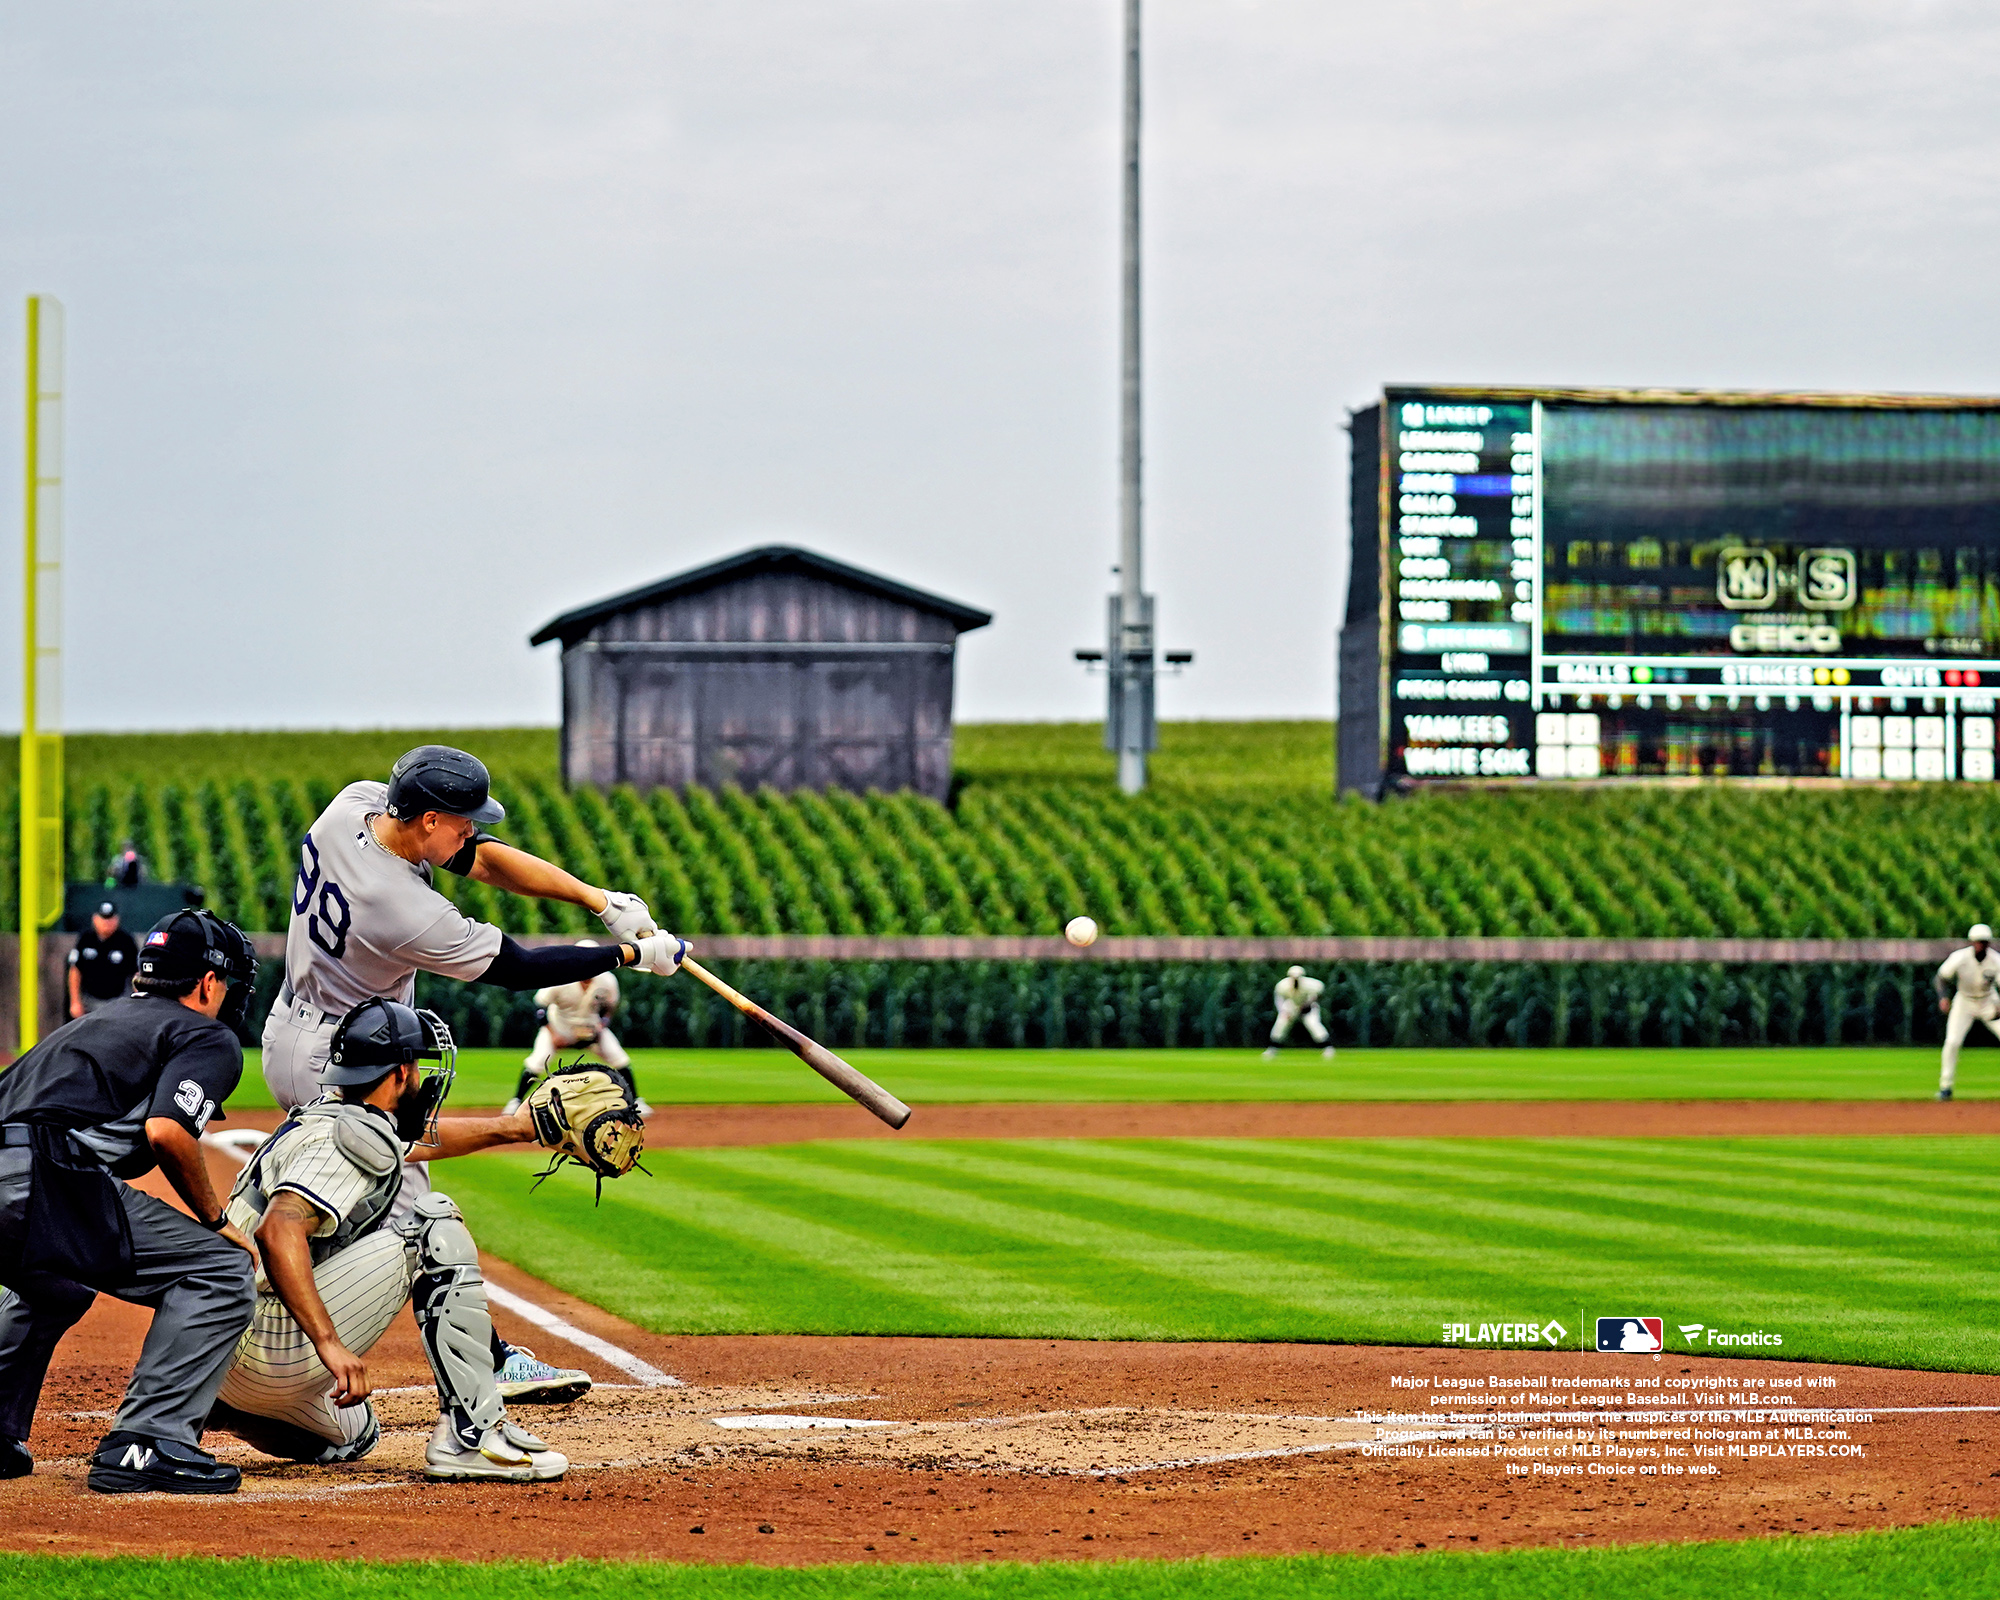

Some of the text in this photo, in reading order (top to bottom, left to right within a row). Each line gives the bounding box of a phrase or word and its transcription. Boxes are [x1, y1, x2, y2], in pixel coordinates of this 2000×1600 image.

[1730, 624, 1842, 652] GEICO
[1557, 663, 1631, 683] BALLS
[1721, 665, 1814, 685] STRIKES
[1880, 666, 1942, 686] OUTS
[1404, 714, 1510, 743] YANKEES
[1404, 747, 1479, 775] WHITE
[1480, 747, 1530, 775] SOX
[294, 833, 351, 959] 99
[174, 1079, 216, 1134] 31
[503, 1370, 548, 1381] DREAMS
